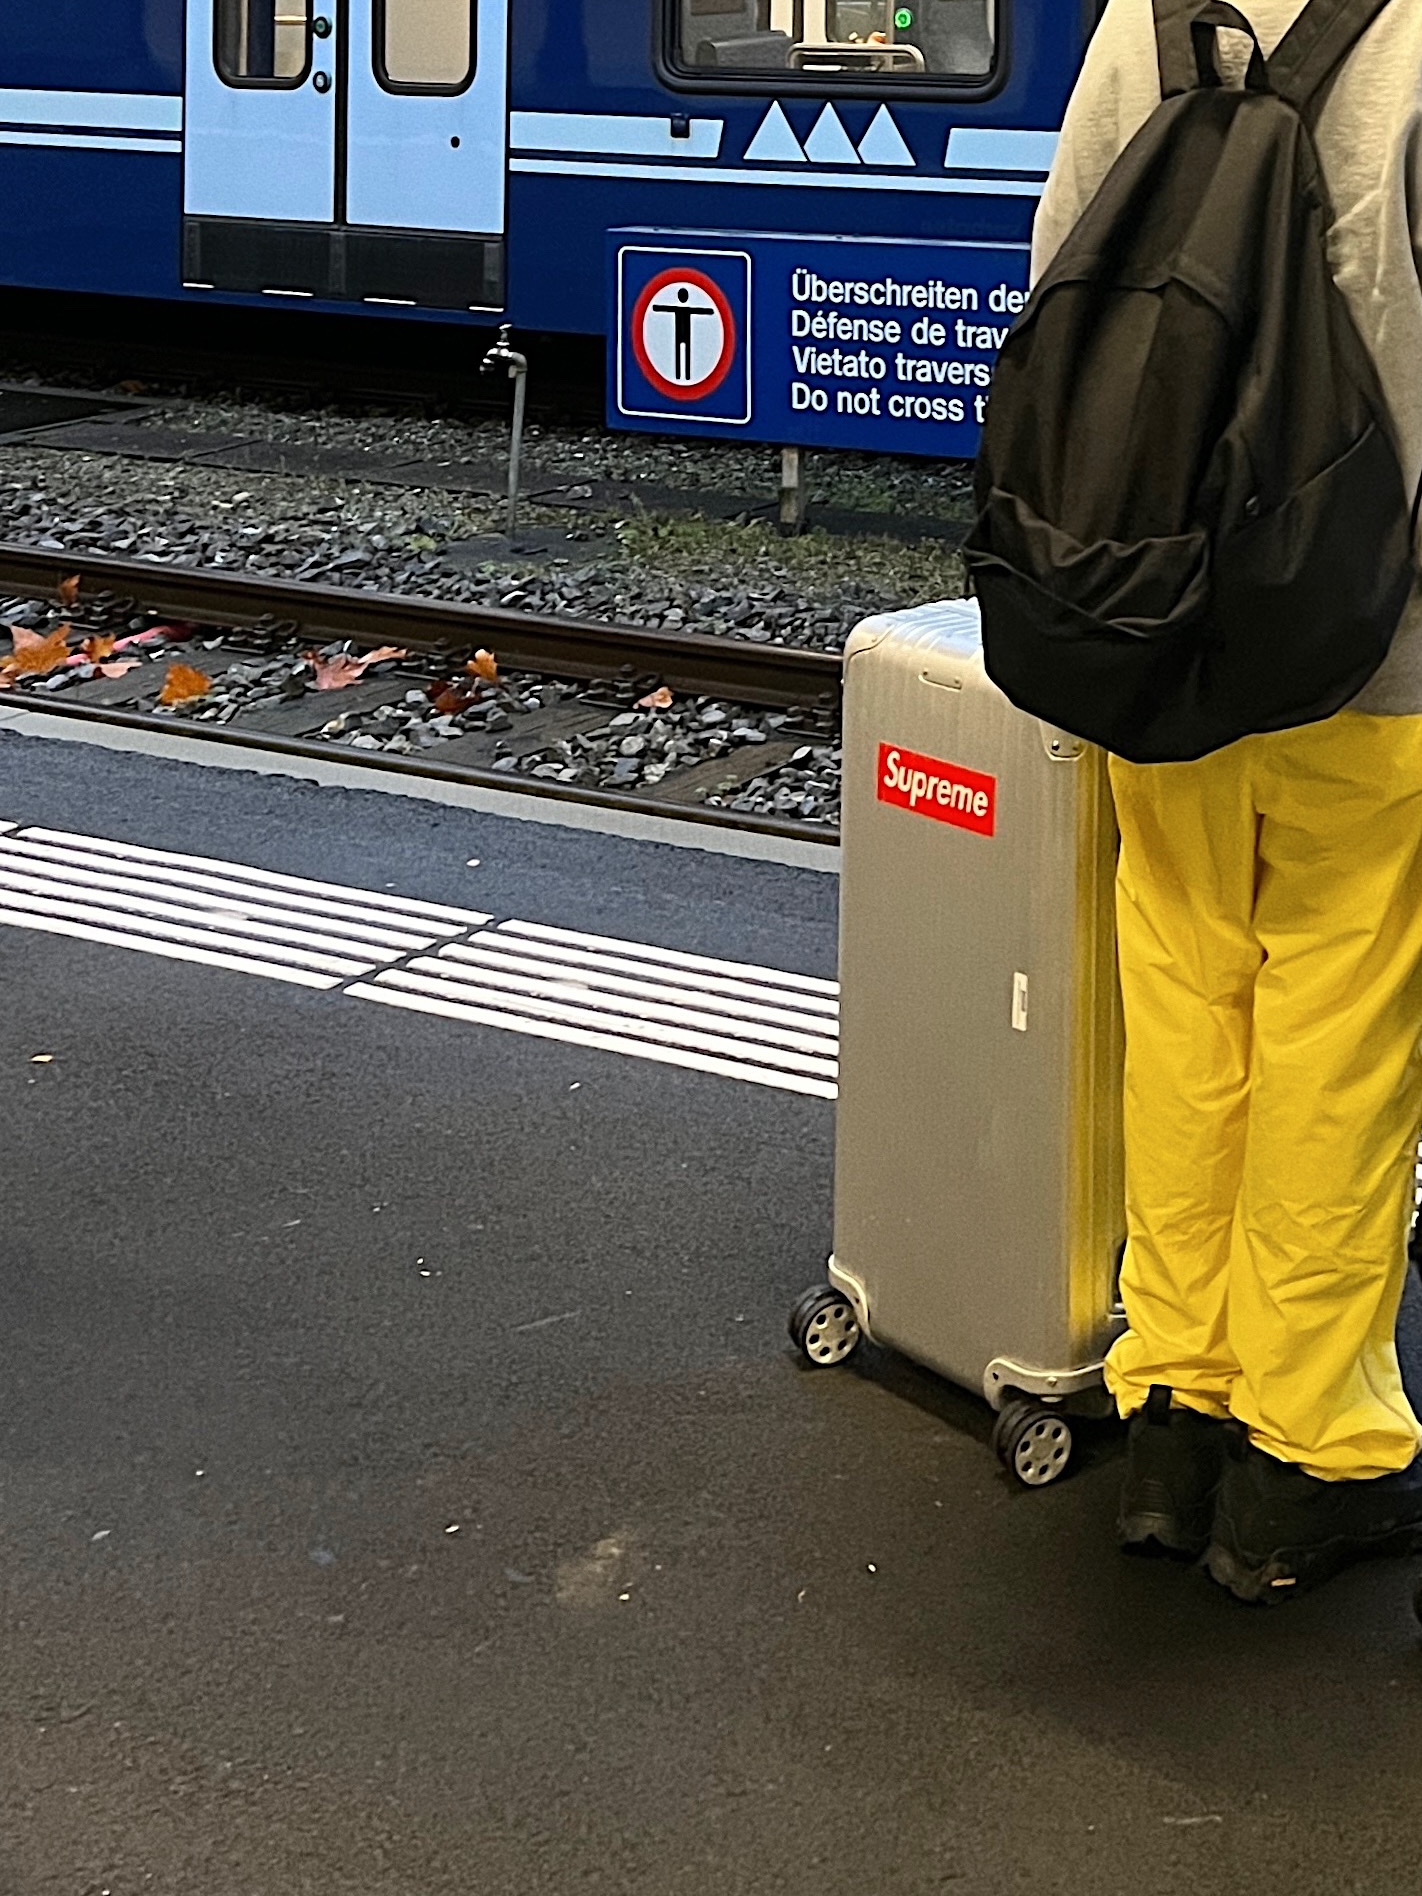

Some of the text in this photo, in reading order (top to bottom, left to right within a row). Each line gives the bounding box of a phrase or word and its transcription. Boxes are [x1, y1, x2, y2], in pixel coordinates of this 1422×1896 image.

[792, 267, 978, 311] Überschreiten
[791, 309, 1009, 349] Défense de trav
[792, 345, 993, 387] Vietato travers
[791, 381, 828, 412] Do
[837, 387, 881, 416] not
[888, 394, 965, 422] cross
[883, 750, 989, 817] Supreme
